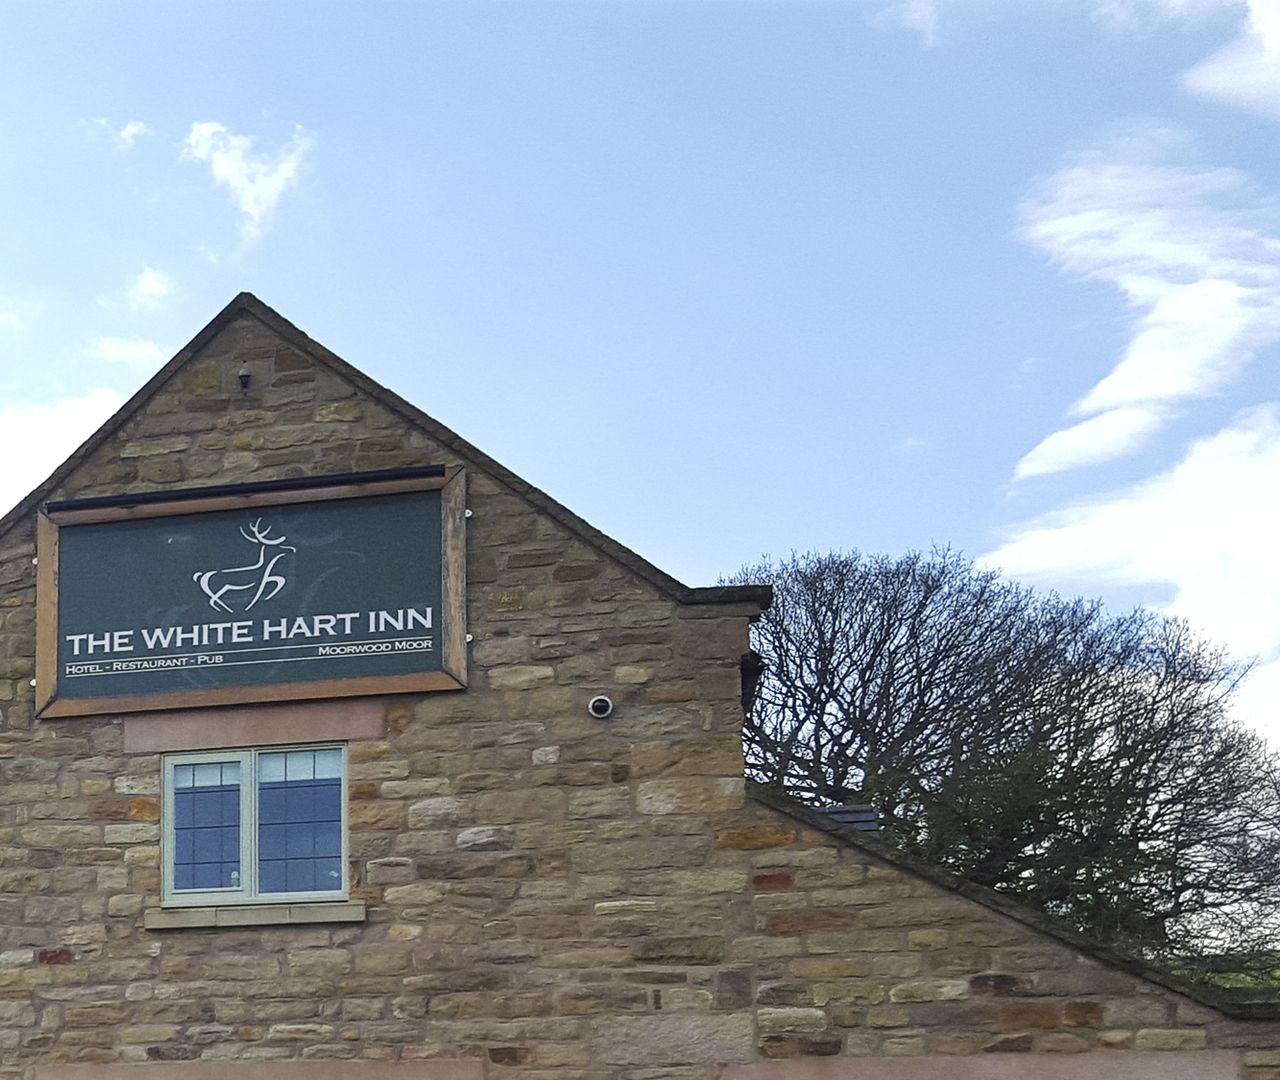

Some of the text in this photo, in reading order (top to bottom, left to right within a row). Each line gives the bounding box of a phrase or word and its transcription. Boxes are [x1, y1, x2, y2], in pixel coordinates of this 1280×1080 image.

[65, 607, 433, 655] THE WHITE HART INN
